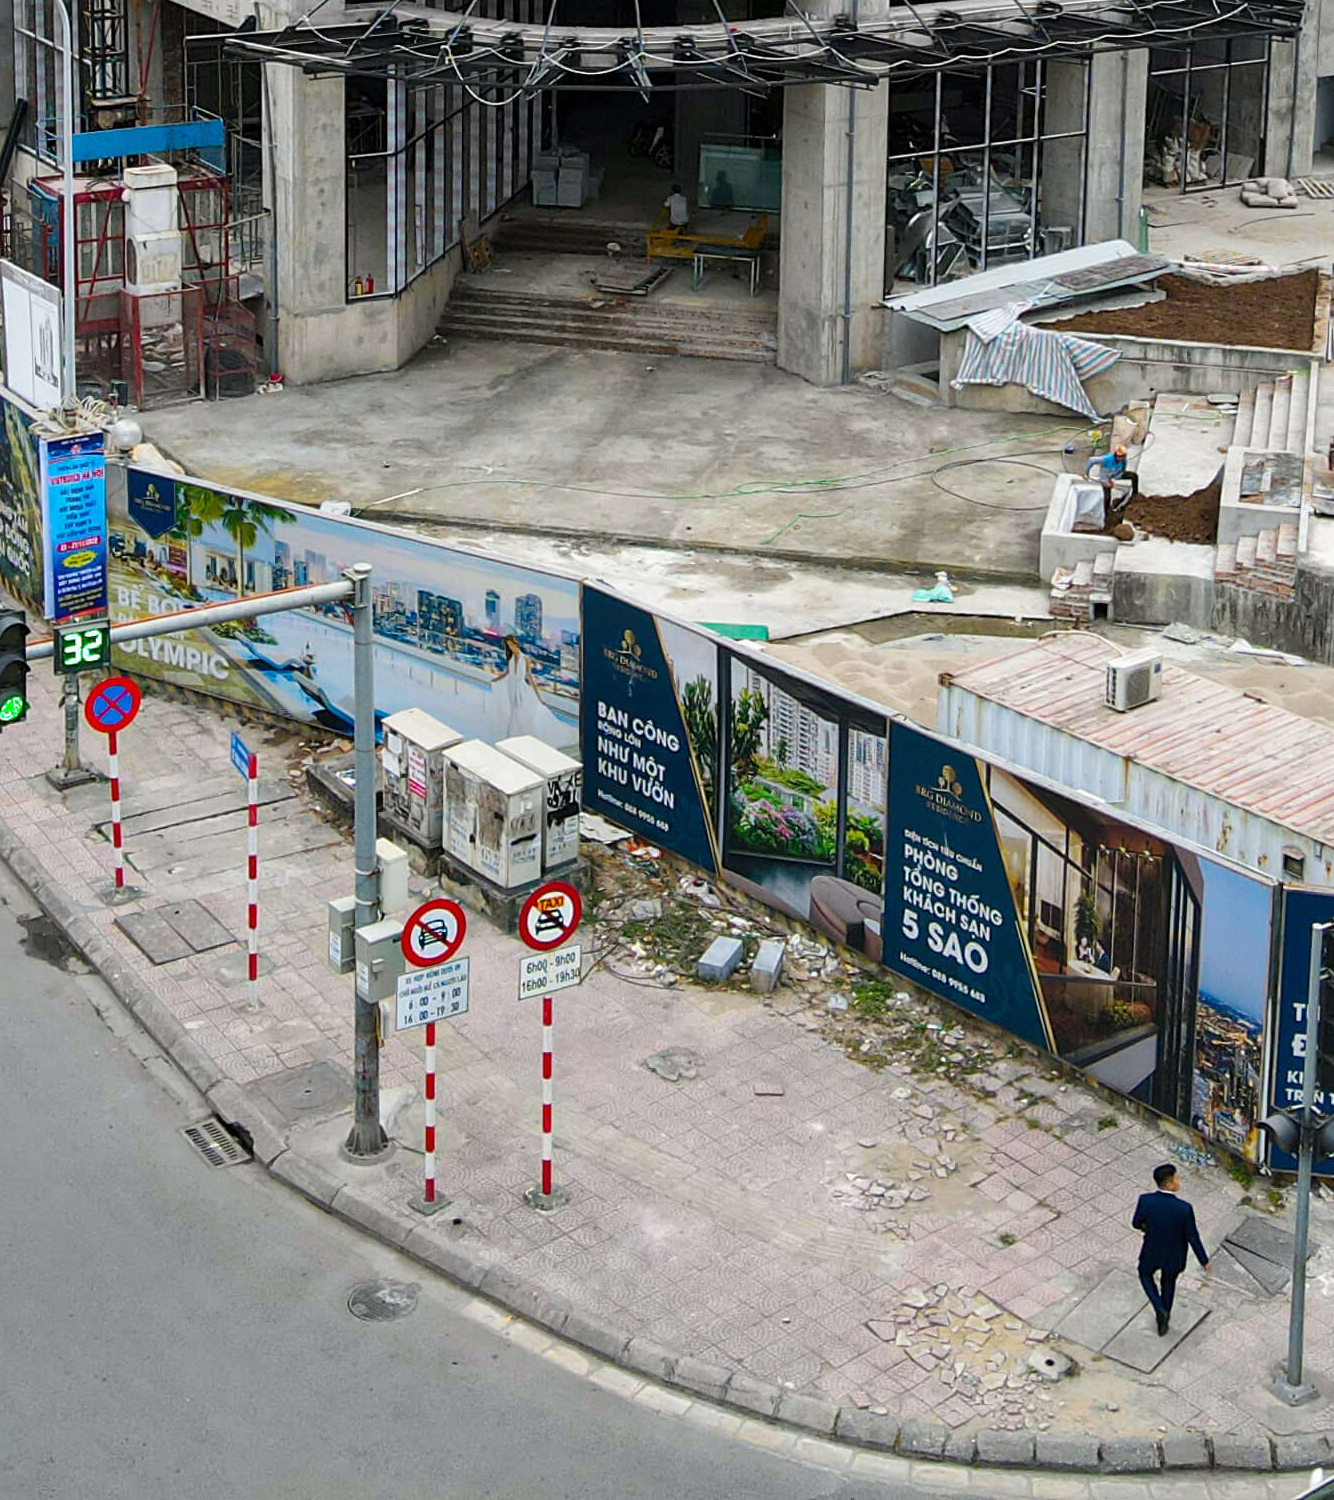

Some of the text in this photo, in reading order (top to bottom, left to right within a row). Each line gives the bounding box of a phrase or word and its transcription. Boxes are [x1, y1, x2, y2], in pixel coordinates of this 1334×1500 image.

[64, 630, 102, 666] 32
[597, 701, 680, 752] BAN CÔNG
[597, 735, 666, 782] NHƯ MỘT
[598, 757, 675, 810] KHU VƯỜN
[936, 794, 982, 823] DIAMOND
[904, 842, 959, 881] PHÒNG
[537, 895, 564, 912] TAXI
[903, 862, 1003, 927] TỔNG THỐNG
[903, 885, 992, 942] KHÁCH SẠN
[902, 908, 989, 974] 5 SAO
[1286, 1088, 1324, 1106] TRN
